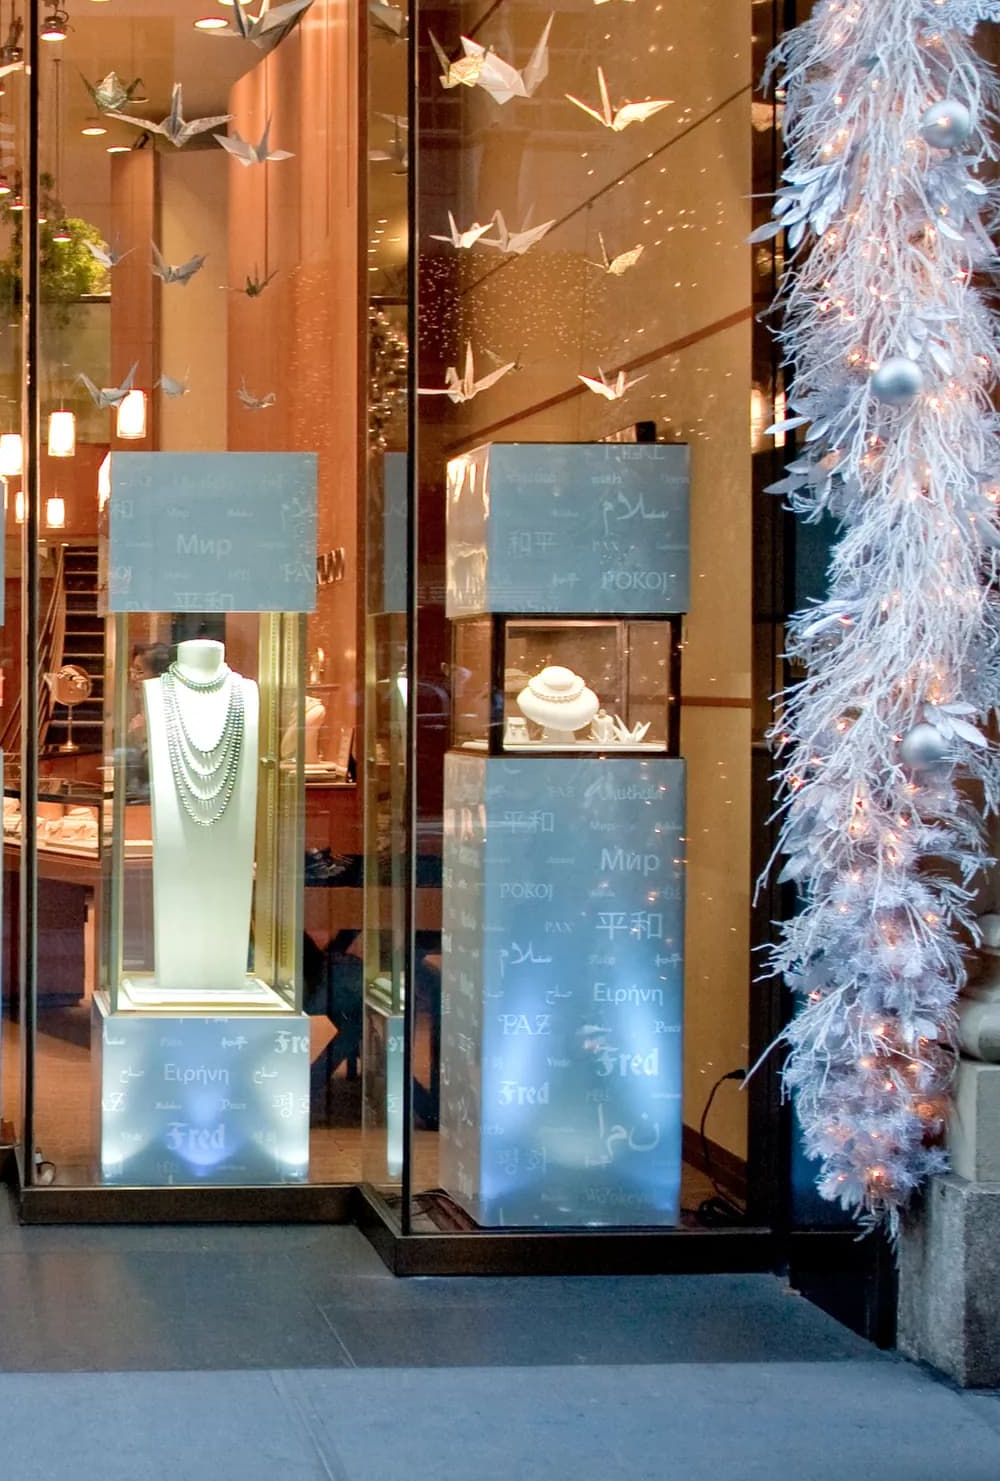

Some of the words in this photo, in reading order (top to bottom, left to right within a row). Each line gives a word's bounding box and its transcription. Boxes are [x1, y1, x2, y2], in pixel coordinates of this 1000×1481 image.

[176, 533, 233, 560] Мир
[503, 810, 555, 834] 平和
[601, 847, 660, 876] Мир
[596, 911, 662, 941] 平和
[593, 982, 664, 1007] Ειρήνη
[164, 1063, 230, 1086] Ειρήνη
[596, 1047, 660, 1078] Fred
[498, 1080, 550, 1105] Fred
[167, 1122, 227, 1150] Fred
